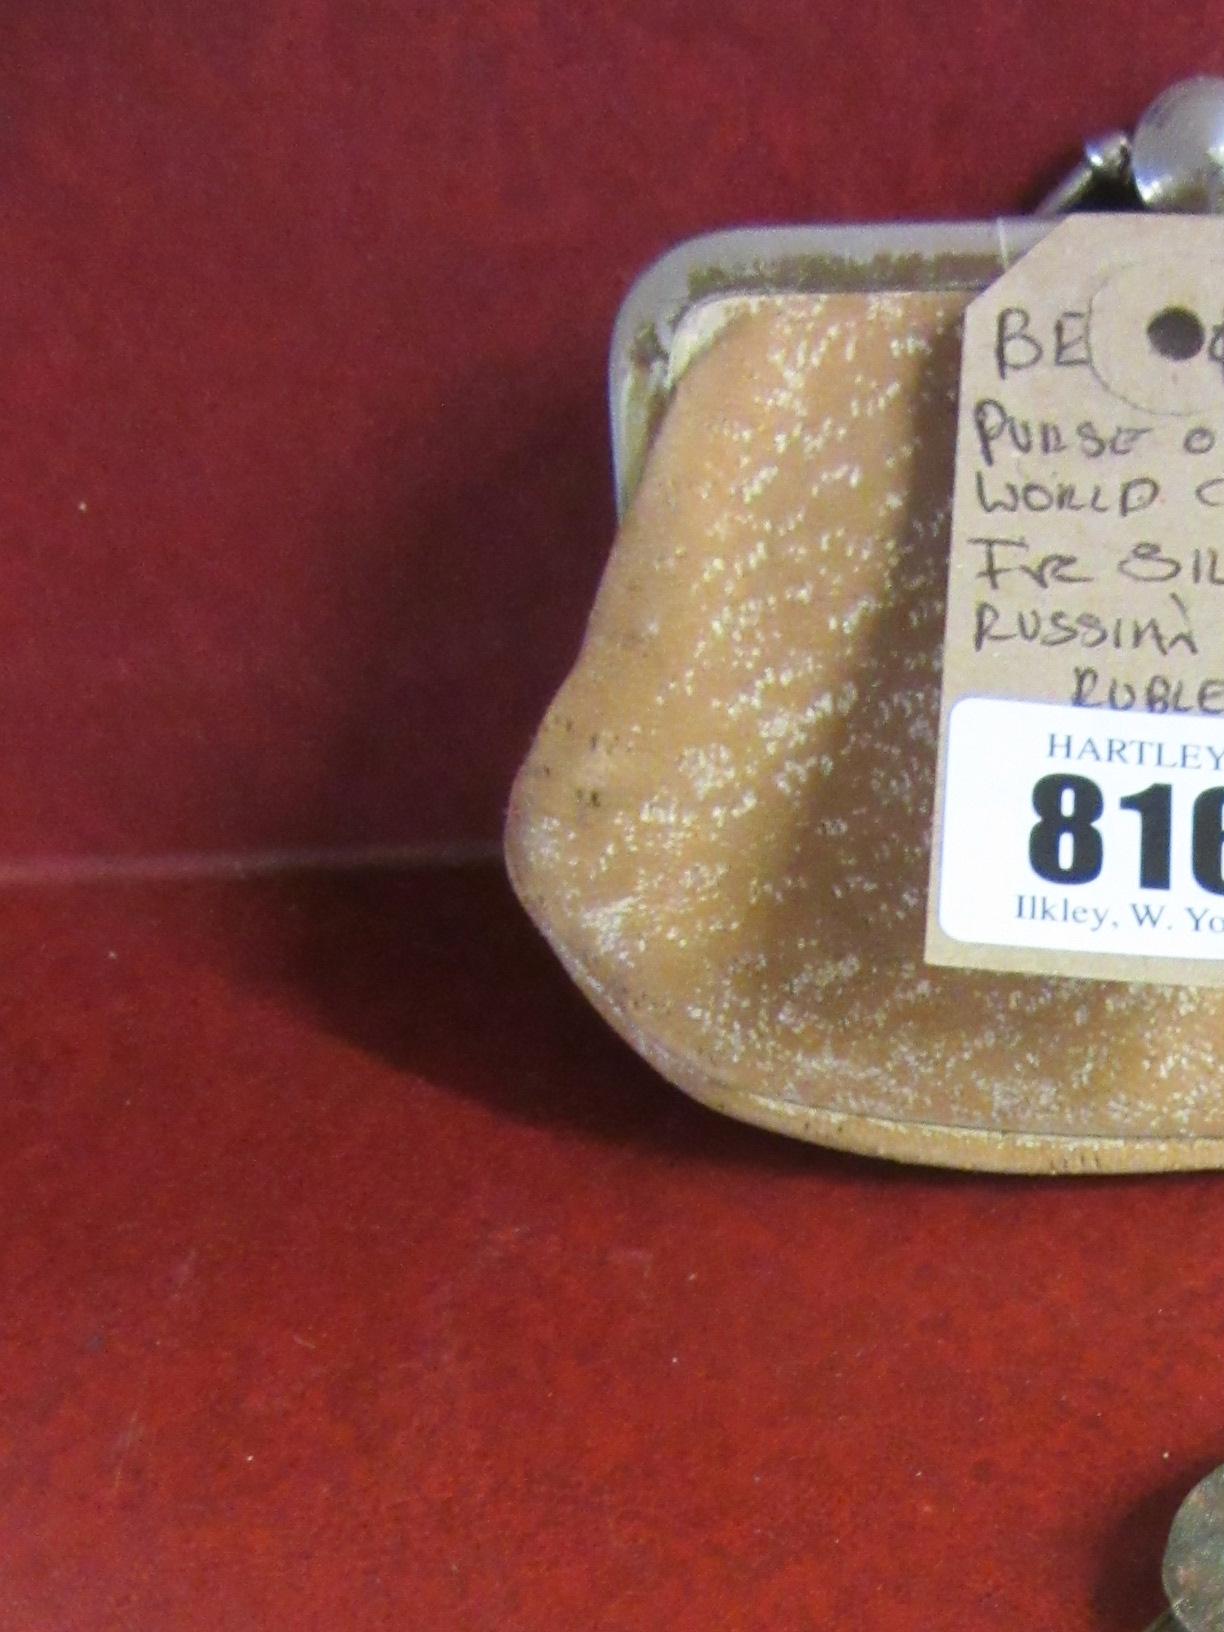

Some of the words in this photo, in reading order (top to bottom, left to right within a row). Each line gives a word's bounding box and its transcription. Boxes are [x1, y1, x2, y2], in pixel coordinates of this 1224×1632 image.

[973, 398, 1152, 466] PURSE
[975, 470, 1161, 518] WORLD
[1015, 895, 1120, 932] Ilkley,
[1130, 902, 1172, 930] W.
